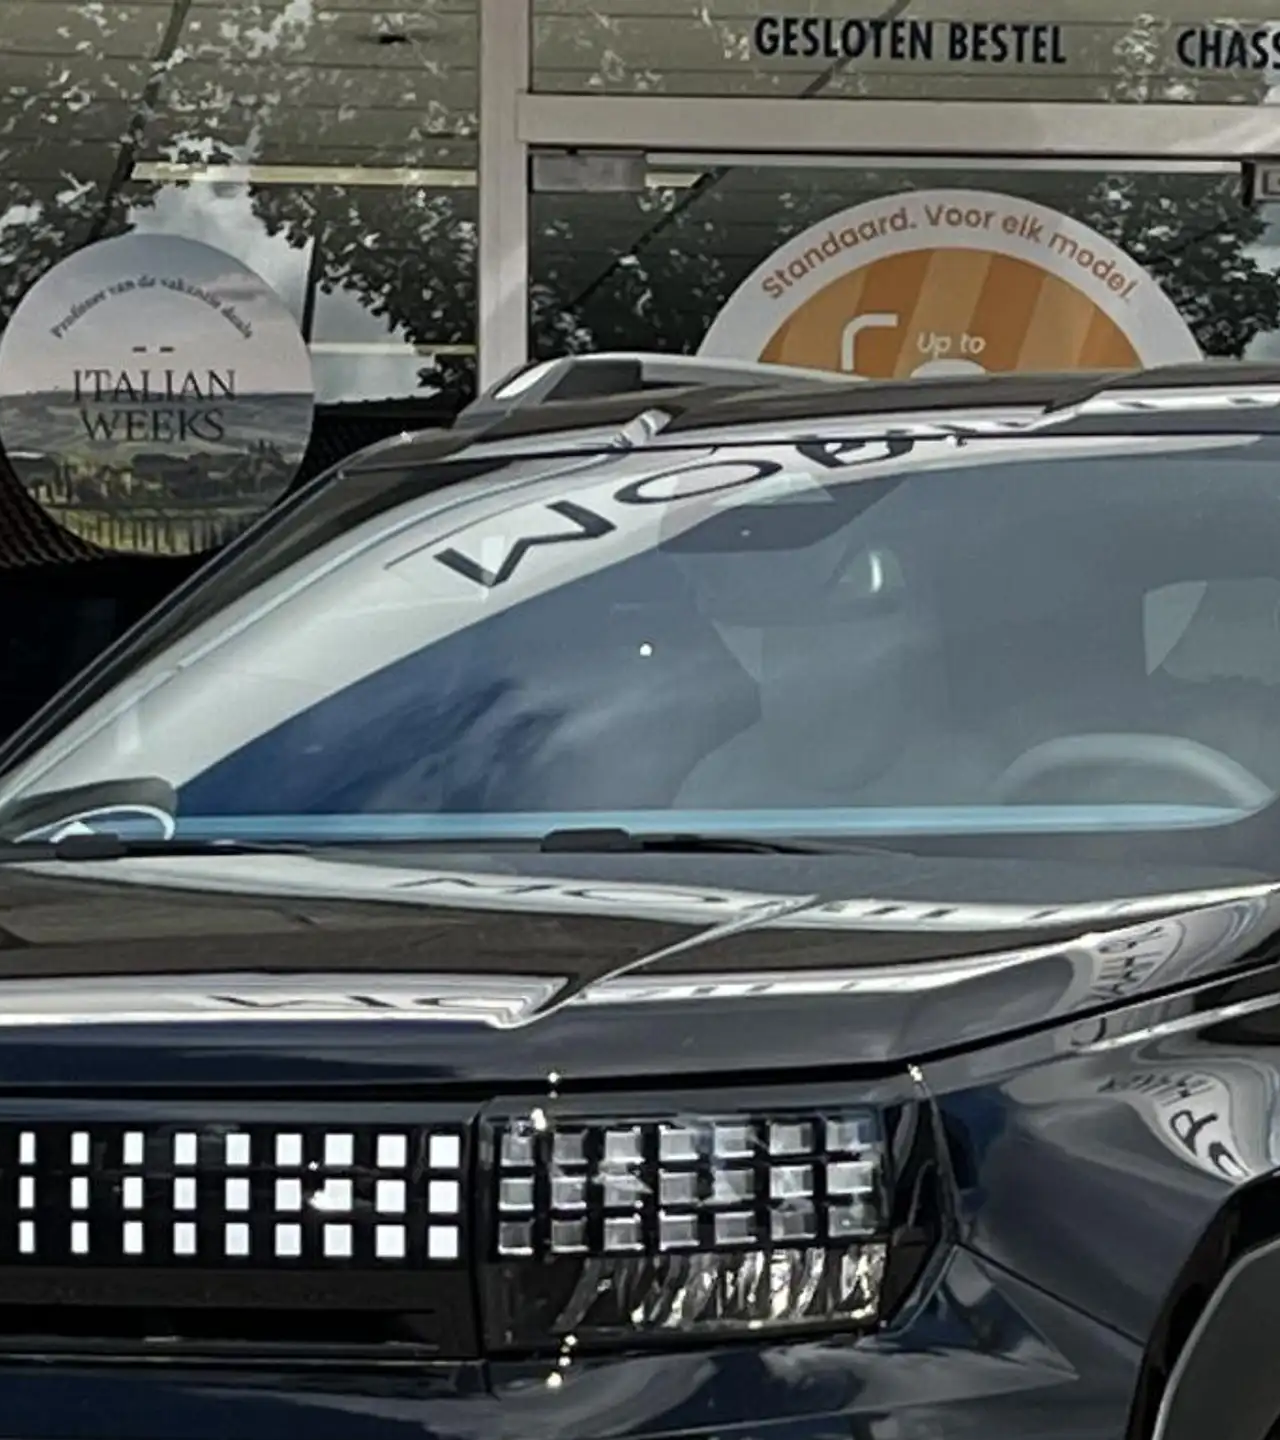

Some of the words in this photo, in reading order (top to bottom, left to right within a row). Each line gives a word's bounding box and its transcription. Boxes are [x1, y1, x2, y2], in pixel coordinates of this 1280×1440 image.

[754, 16, 934, 61] GESLOTEN
[949, 23, 1066, 65] BESTEL
[761, 207, 917, 300] Standaard.
[924, 204, 996, 230] Voor
[1001, 213, 1044, 244] elk
[916, 332, 952, 360] Up
[960, 332, 987, 354] to
[72, 369, 235, 402] ITALIAN
[80, 410, 225, 443] WEEKS
